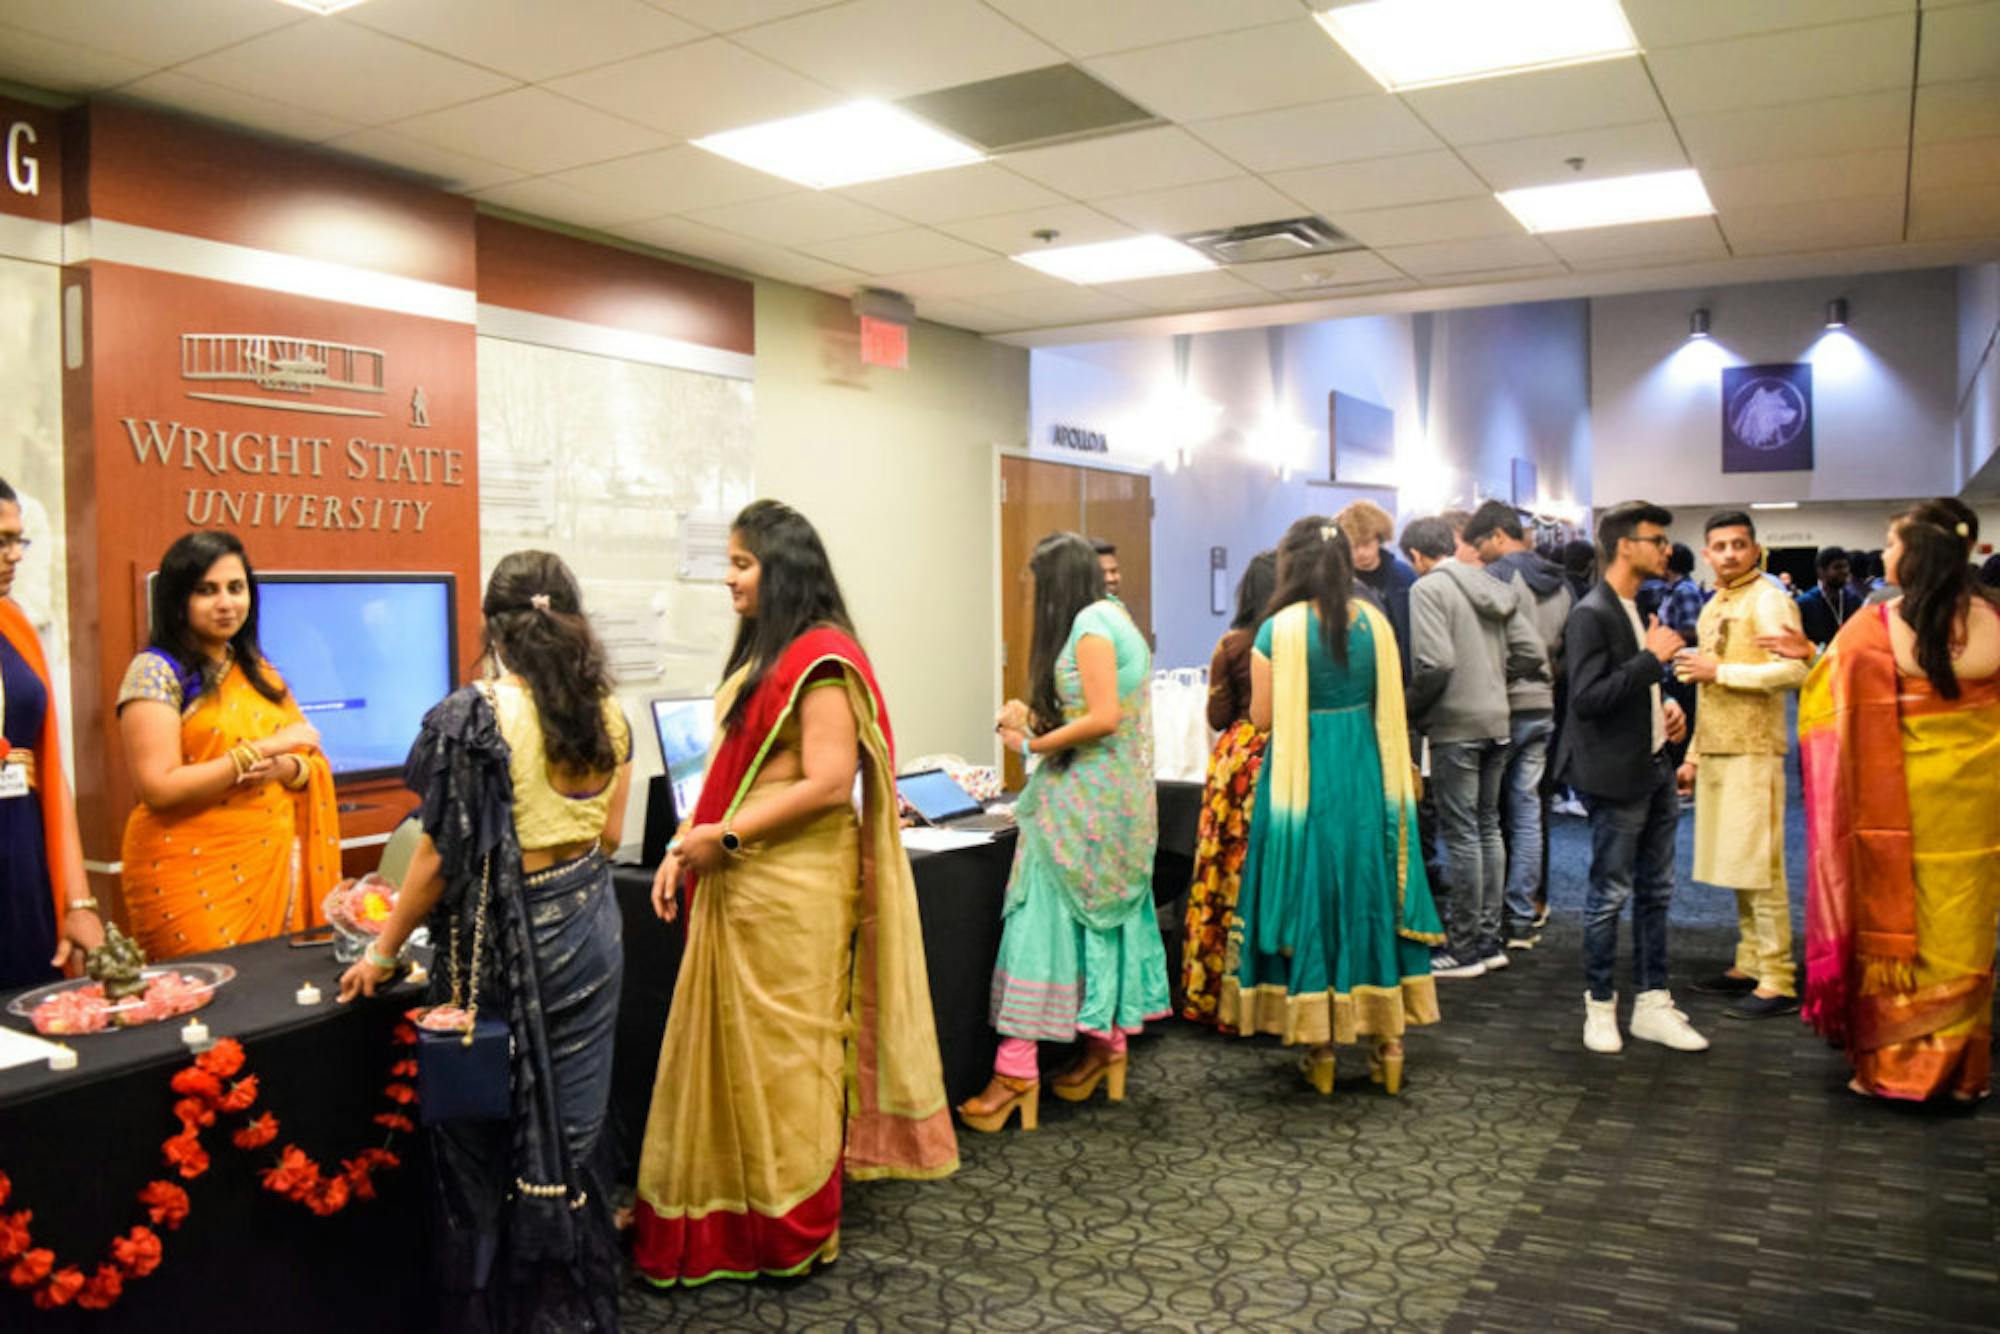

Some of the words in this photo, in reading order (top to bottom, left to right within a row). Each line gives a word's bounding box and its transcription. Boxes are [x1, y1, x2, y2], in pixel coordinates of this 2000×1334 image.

[6, 121, 40, 196] G
[122, 418, 331, 476] WRIGHT
[347, 438, 465, 486] STATE
[185, 488, 432, 532] UNIVERSITY
